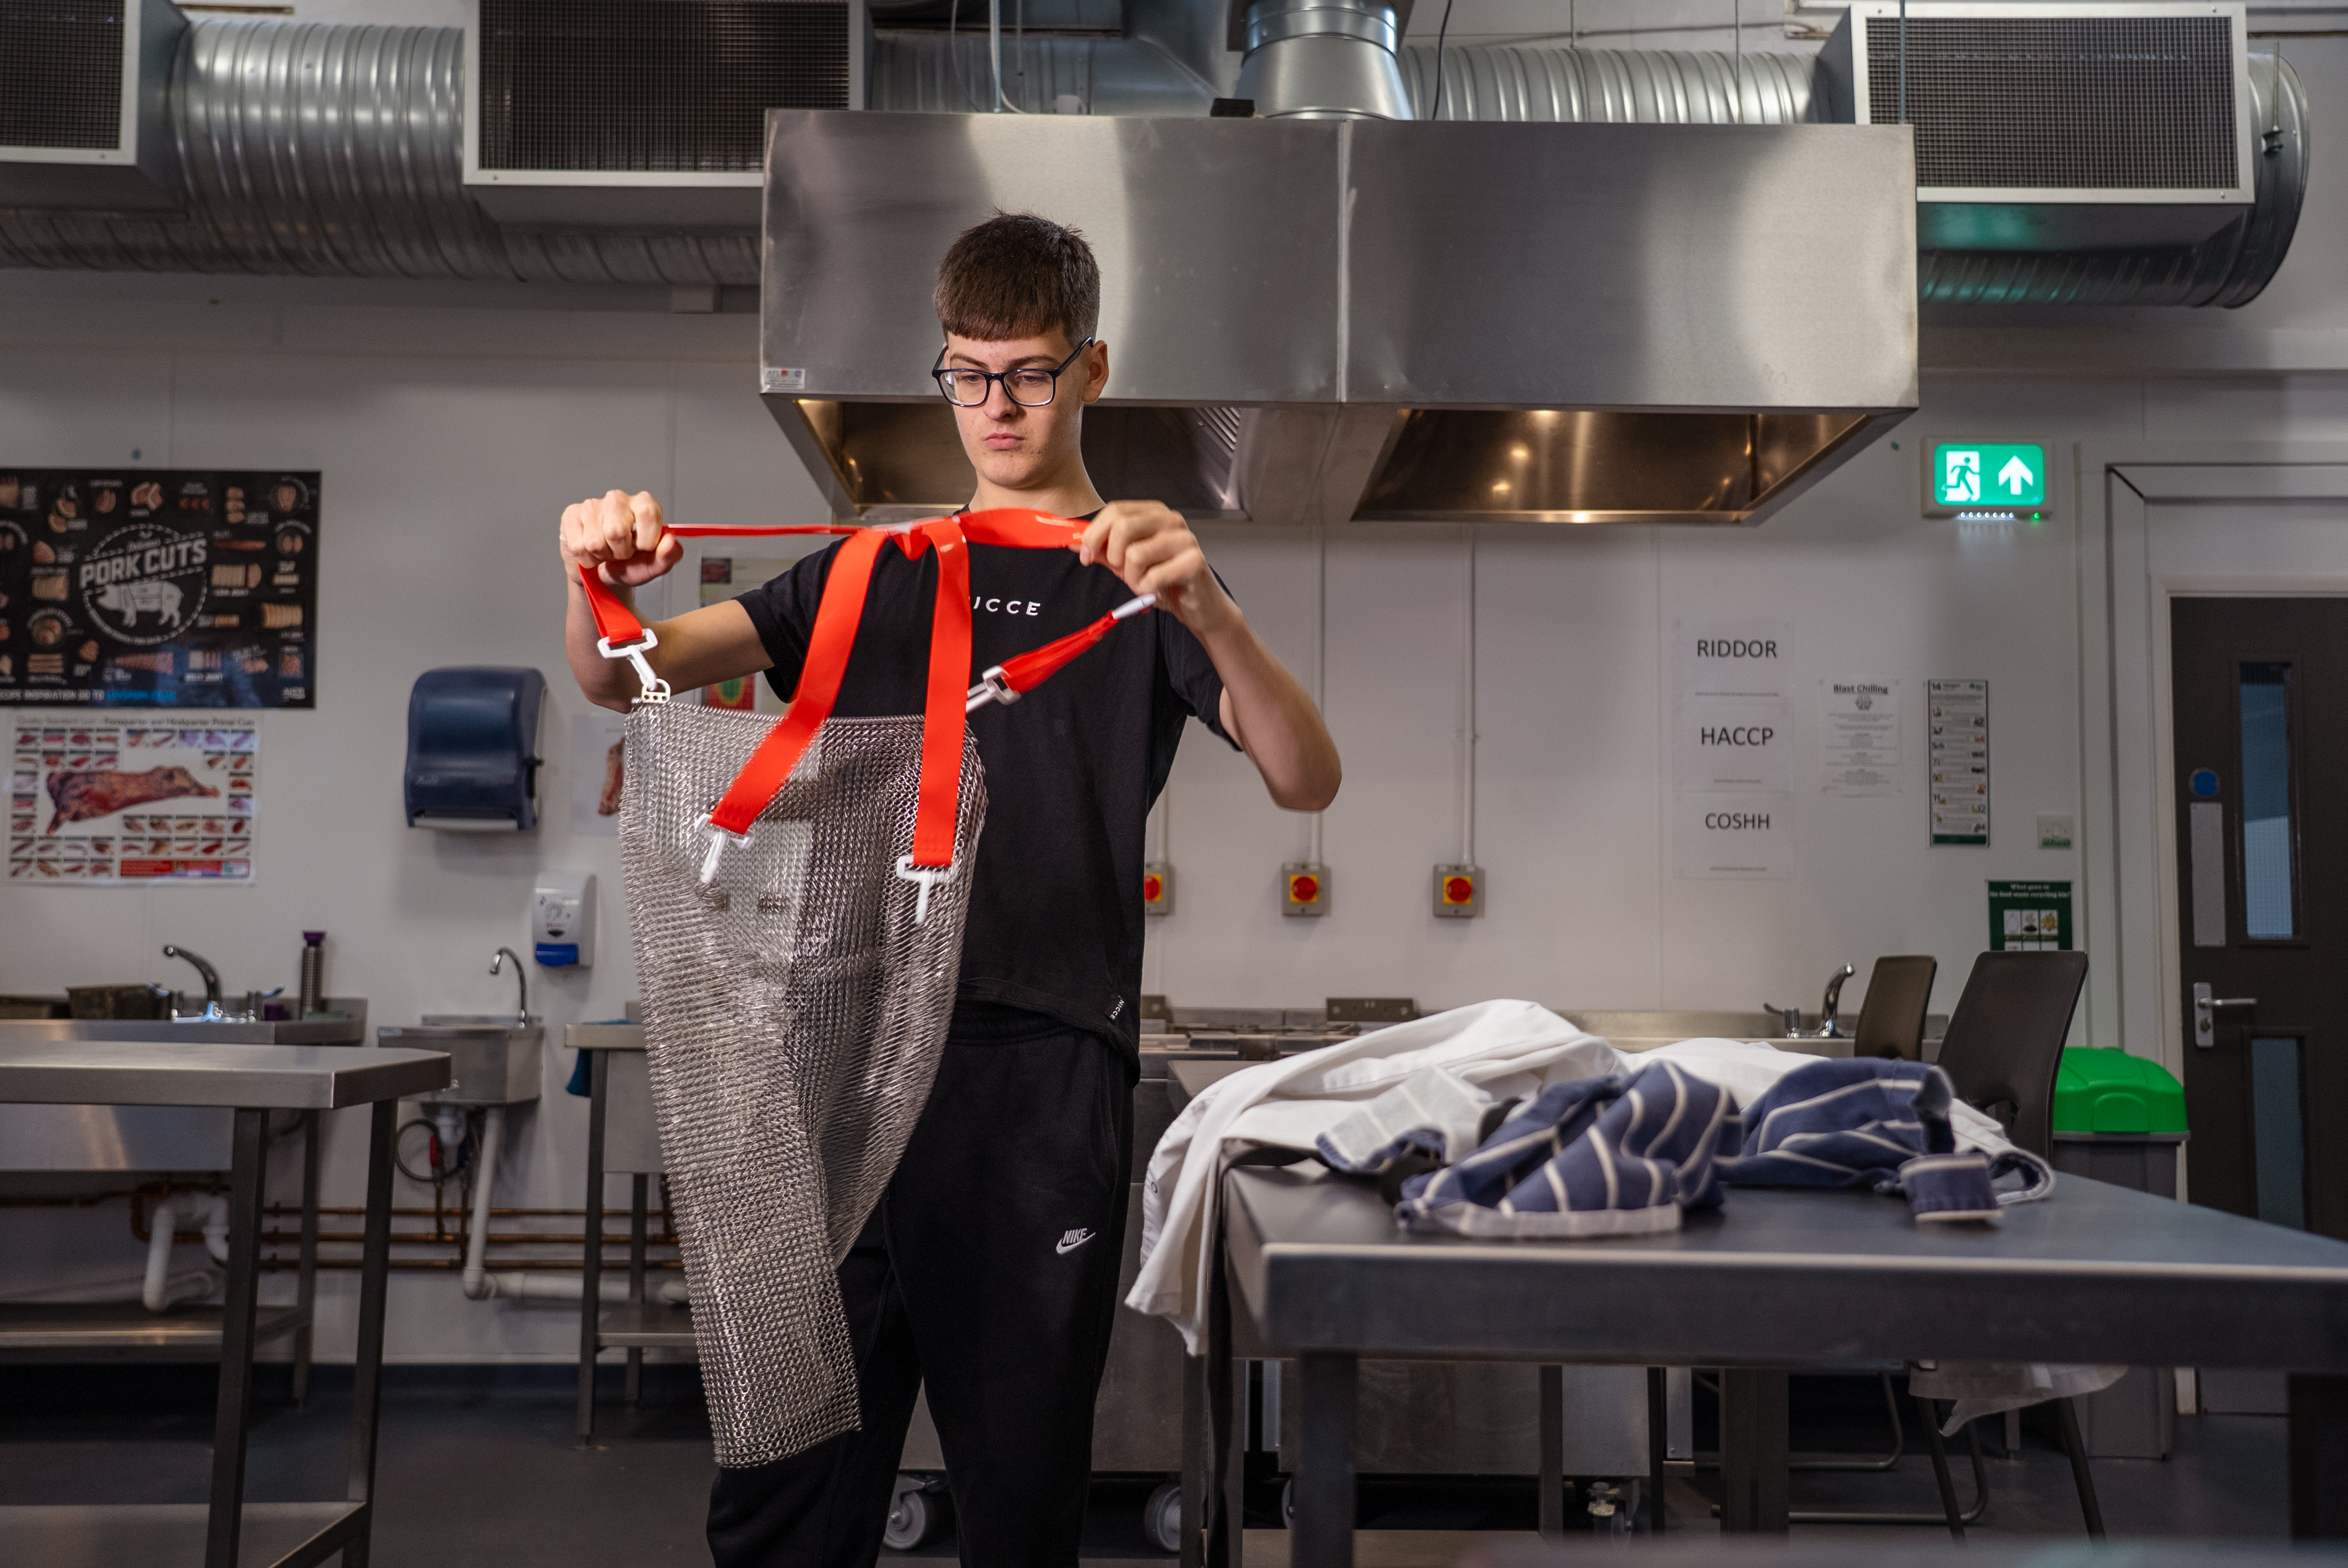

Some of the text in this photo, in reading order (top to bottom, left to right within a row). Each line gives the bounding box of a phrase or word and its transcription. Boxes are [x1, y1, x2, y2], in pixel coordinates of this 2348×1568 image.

[79, 553, 141, 589] PORK
[143, 538, 207, 574] CUTS
[972, 596, 1041, 616] ICCE
[1697, 639, 1777, 658] RIDDOR
[0, 689, 21, 700] ECIPE
[92, 689, 105, 700] TO
[1834, 683, 1888, 694] Blast Chilling
[1701, 726, 1773, 746] HACCP
[1705, 813, 1769, 829] COSHH
[1110, 999, 1125, 1020] NICCE
[1062, 1227, 1087, 1244] NIKE
